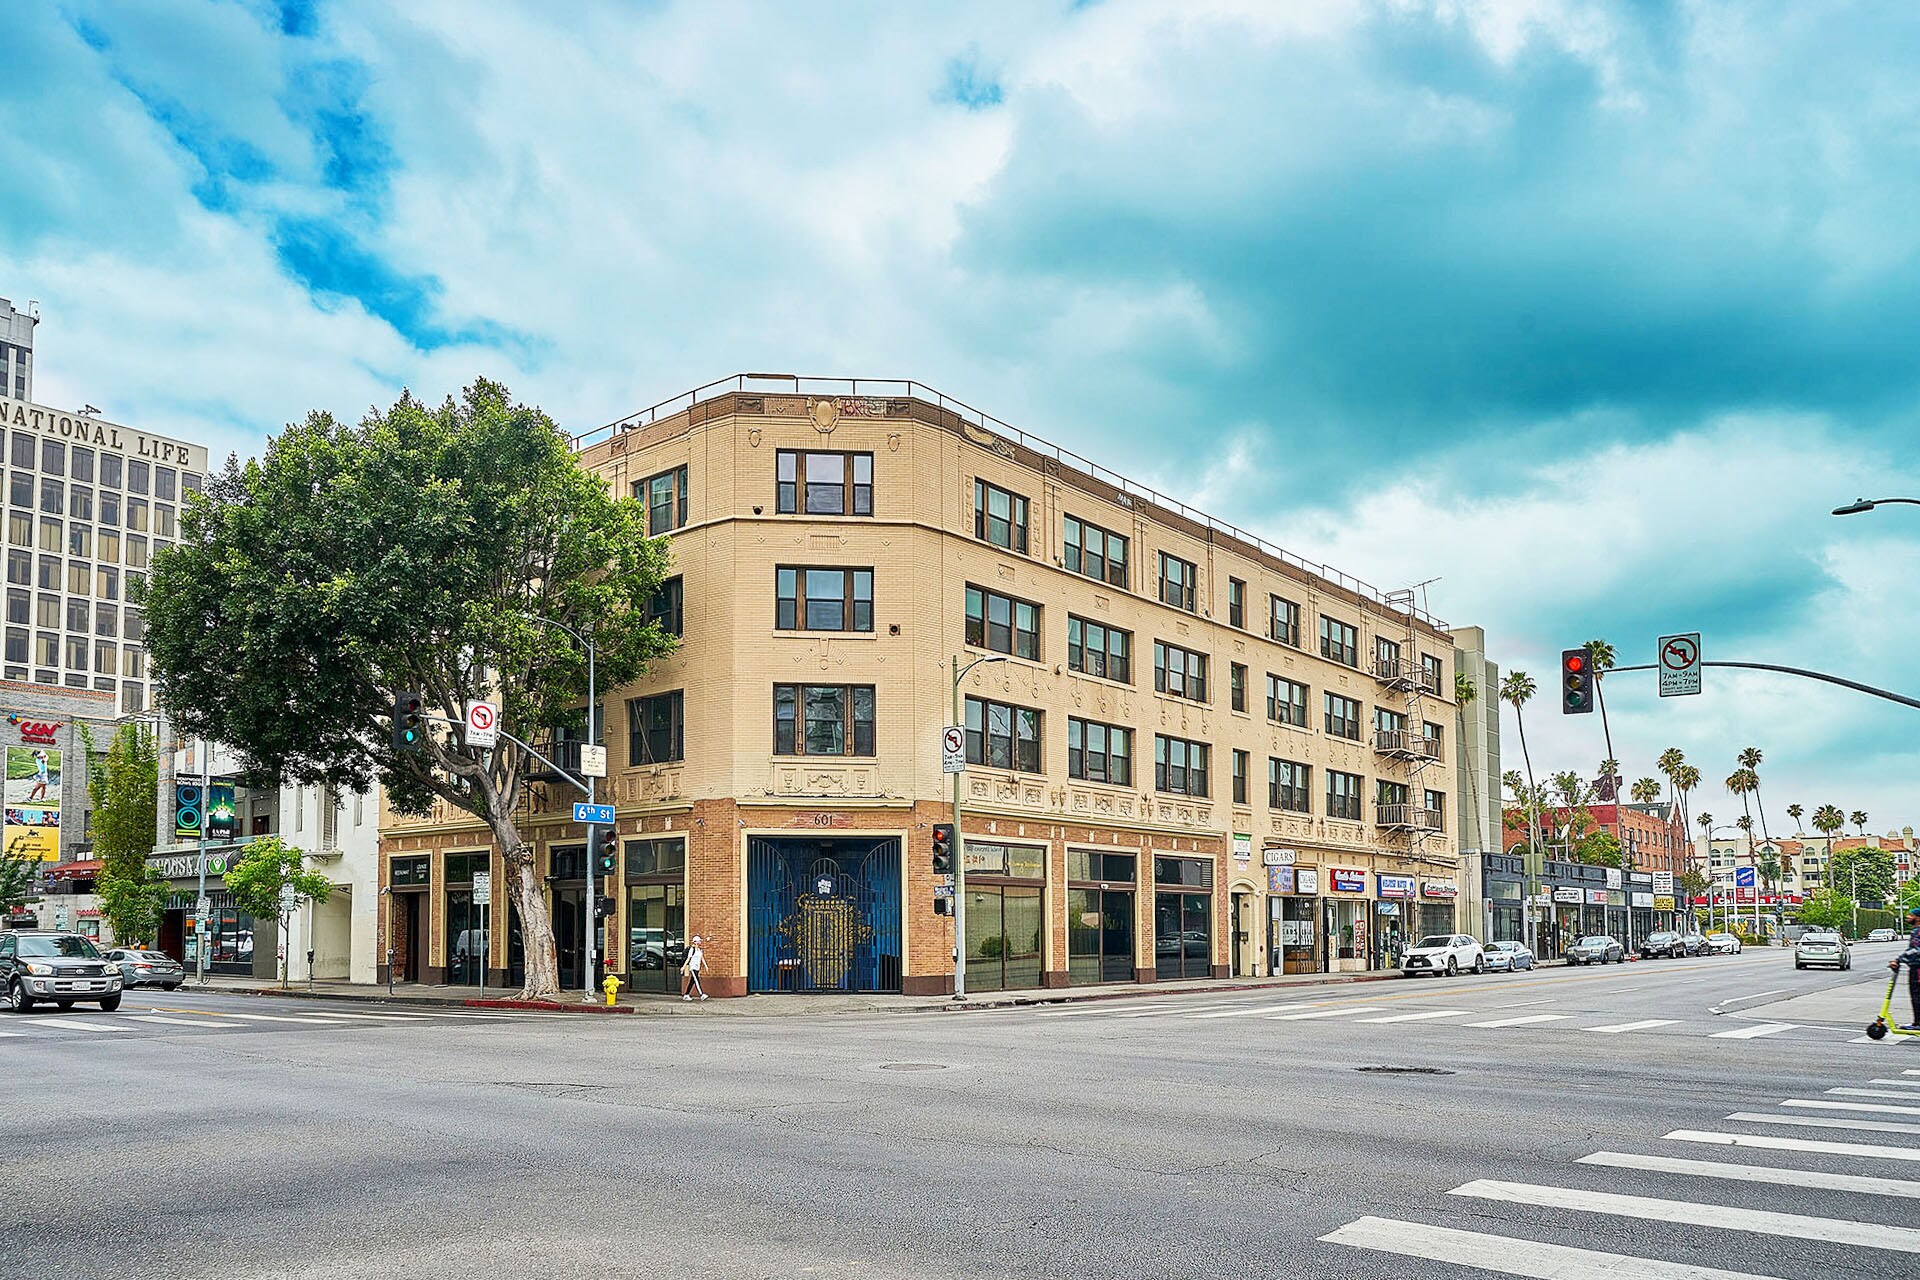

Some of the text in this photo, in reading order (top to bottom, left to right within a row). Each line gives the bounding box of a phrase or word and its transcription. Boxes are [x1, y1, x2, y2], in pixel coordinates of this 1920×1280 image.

[137, 436, 190, 465] LIFE
[20, 721, 58, 738] CGV
[578, 806, 610, 820] 6th St
[814, 814, 833, 826] 601
[1265, 852, 1294, 863] CIGARS
